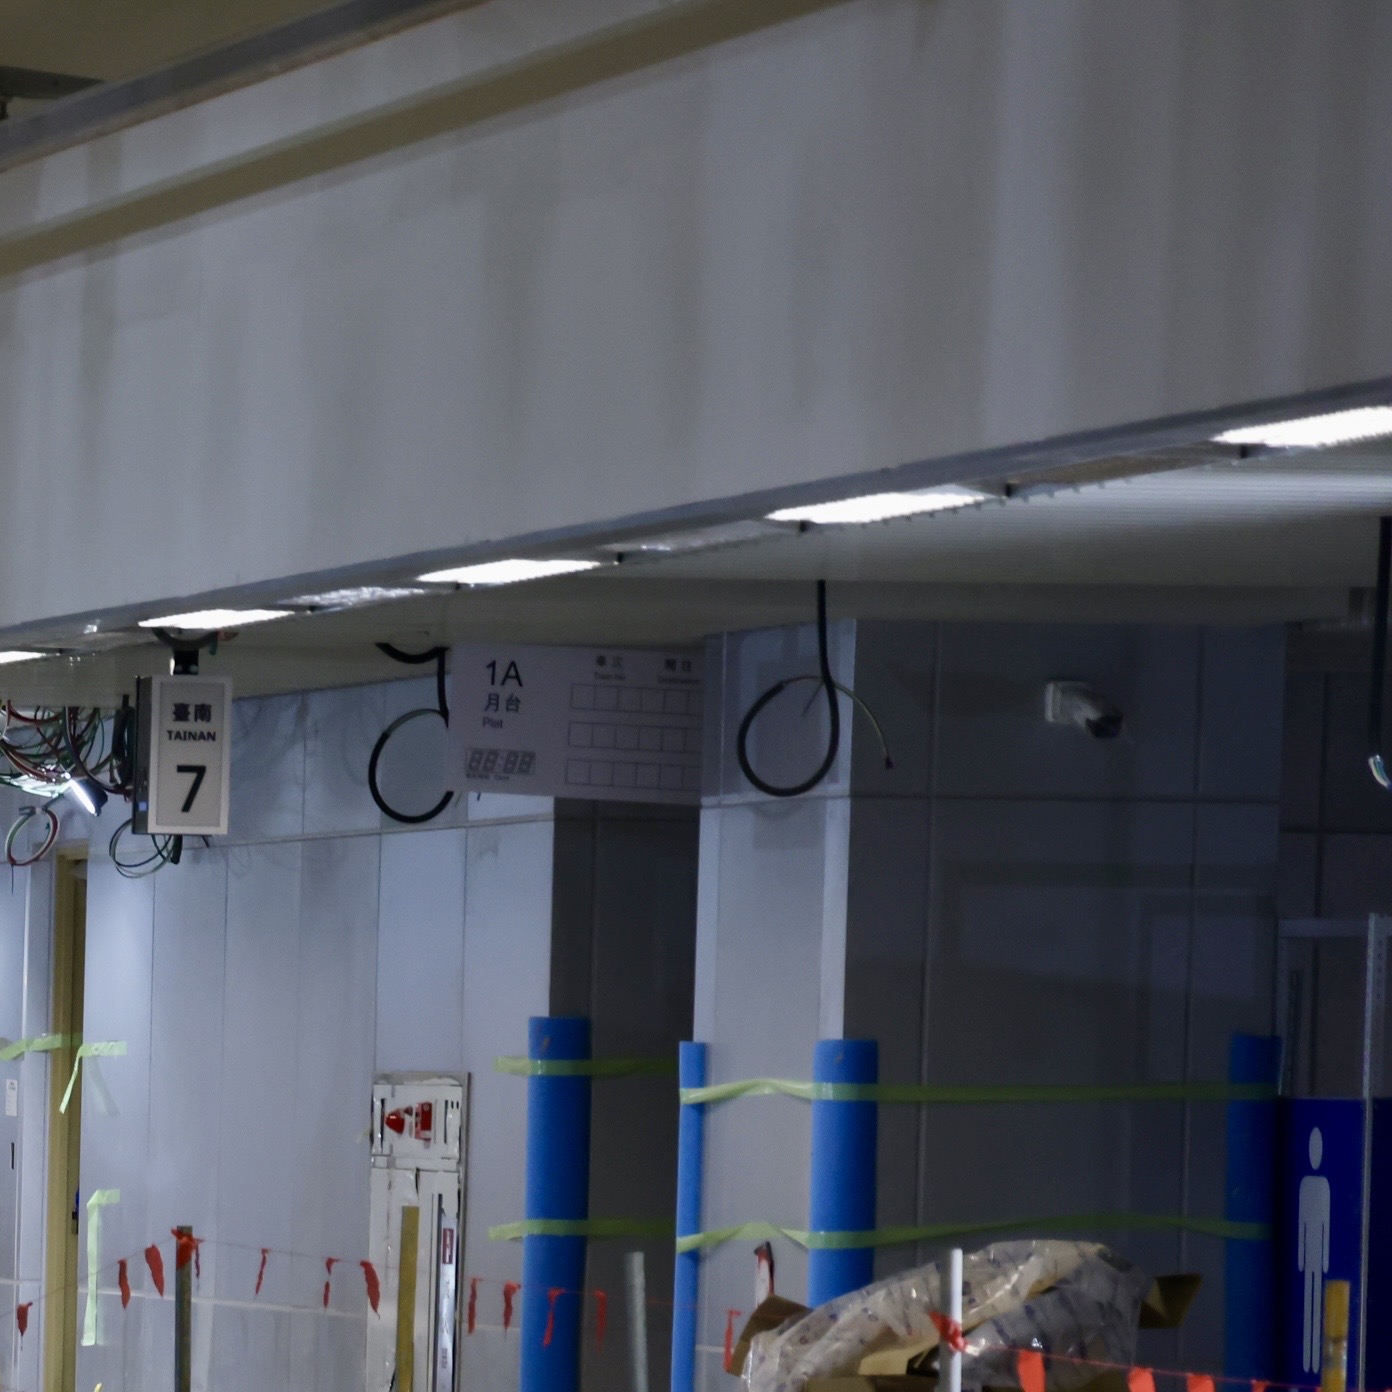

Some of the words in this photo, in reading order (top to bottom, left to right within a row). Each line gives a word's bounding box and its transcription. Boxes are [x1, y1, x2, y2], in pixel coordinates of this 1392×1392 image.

[485, 659, 524, 688] 1A
[173, 703, 213, 723] 臺南
[484, 692, 522, 714] 月台
[166, 729, 217, 742] TAINAN
[176, 765, 207, 813] 7
